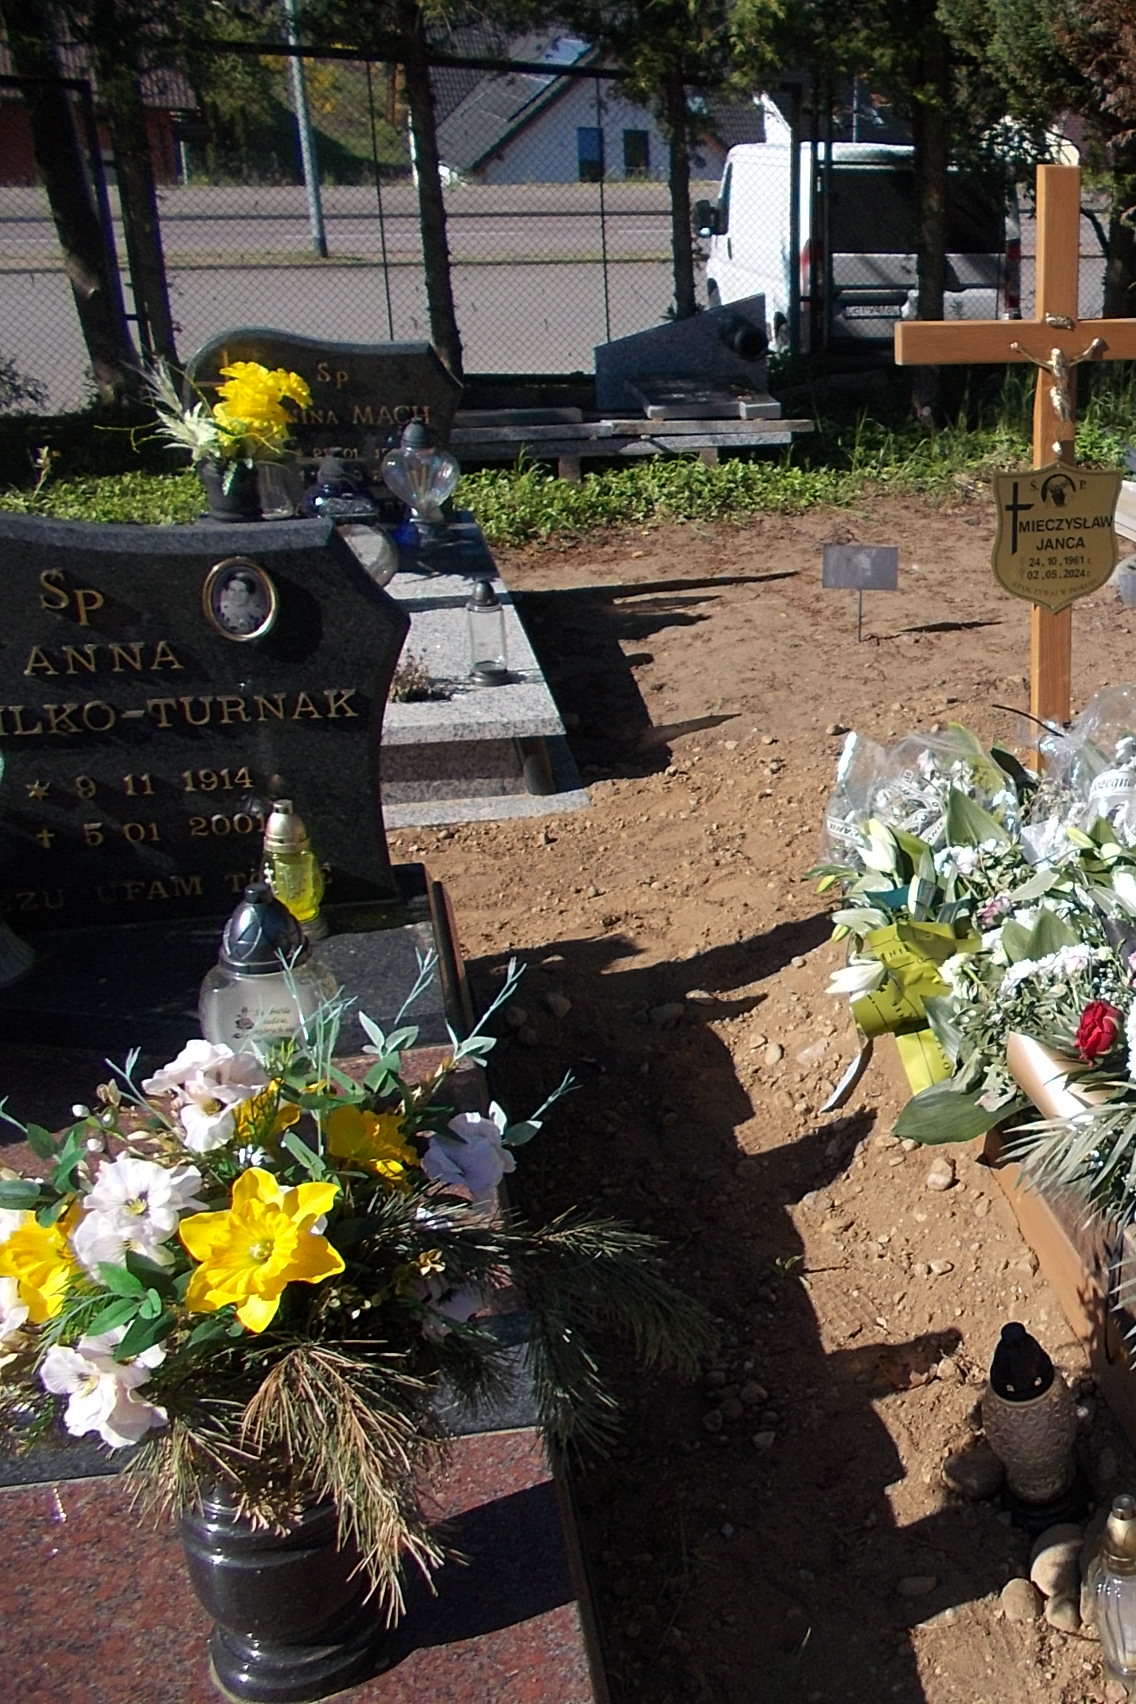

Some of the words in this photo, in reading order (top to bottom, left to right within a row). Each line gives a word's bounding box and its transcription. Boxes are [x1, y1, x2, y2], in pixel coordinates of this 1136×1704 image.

[352, 404, 431, 425] MACH
[1018, 515, 1114, 533] MIECZYSŁAW
[1035, 536, 1086, 551] JANCA
[23, 639, 184, 678] ANNA
[75, 774, 98, 800] 9
[122, 772, 156, 798] 11
[182, 765, 255, 793] 1914
[82, 821, 106, 848] 5
[121, 821, 162, 844] 01
[187, 812, 266, 838] 2001
